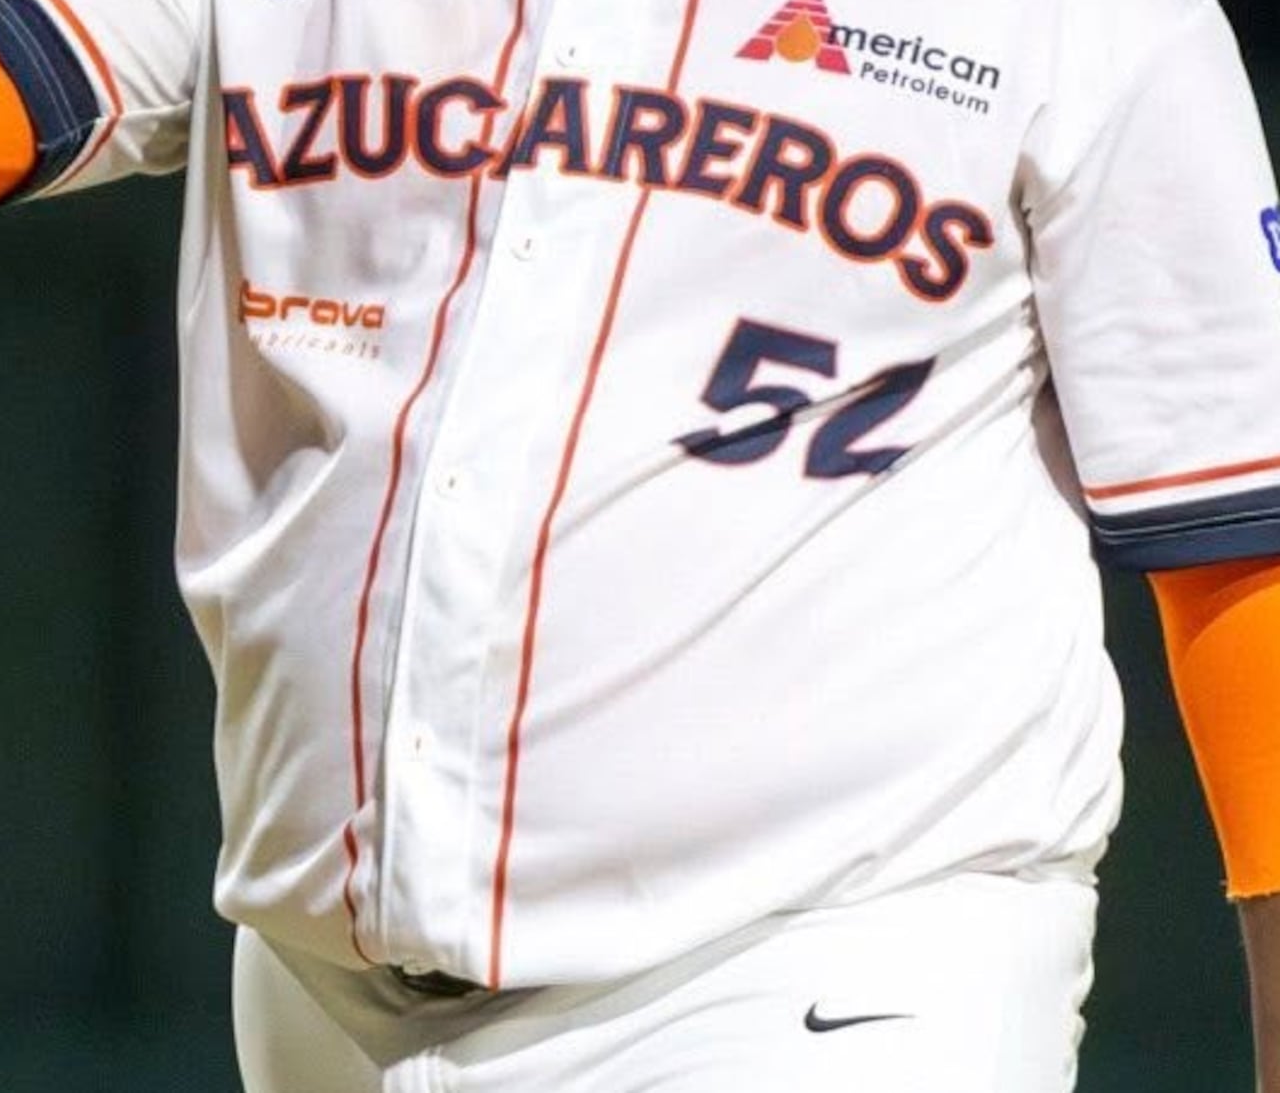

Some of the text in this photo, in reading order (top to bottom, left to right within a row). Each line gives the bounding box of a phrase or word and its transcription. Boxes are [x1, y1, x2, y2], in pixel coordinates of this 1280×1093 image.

[859, 60, 990, 115] Petroleum
[221, 71, 995, 303] AZUCAREROS
[239, 278, 386, 329] brava
